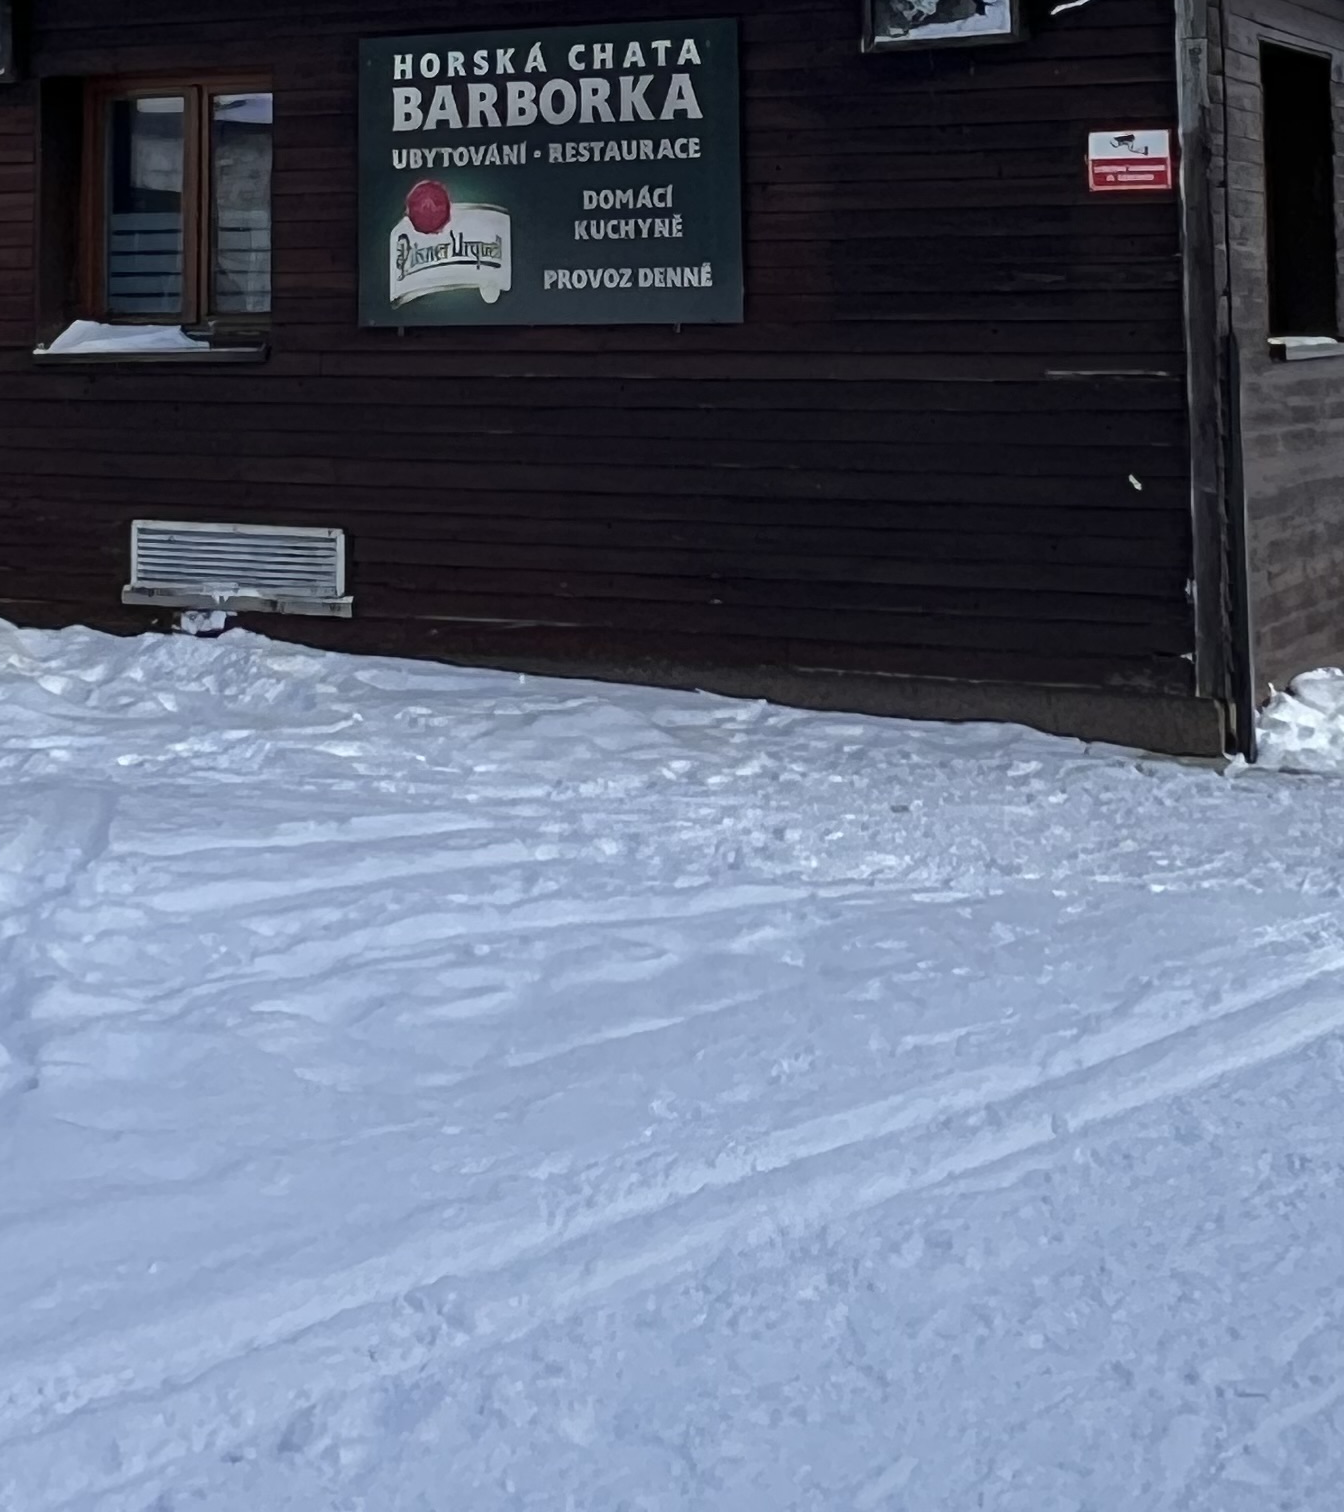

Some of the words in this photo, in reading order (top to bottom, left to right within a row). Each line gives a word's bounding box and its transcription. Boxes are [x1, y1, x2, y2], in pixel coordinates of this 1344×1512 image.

[393, 42, 547, 80] HORSKÁ
[568, 39, 701, 71] CHATA
[392, 73, 703, 132] BARBORKA
[548, 138, 701, 163] RESTAURACE
[574, 214, 683, 240] KUCHYNĚ
[544, 268, 632, 289] PROVOZ
[638, 262, 713, 288] DENNĚ
